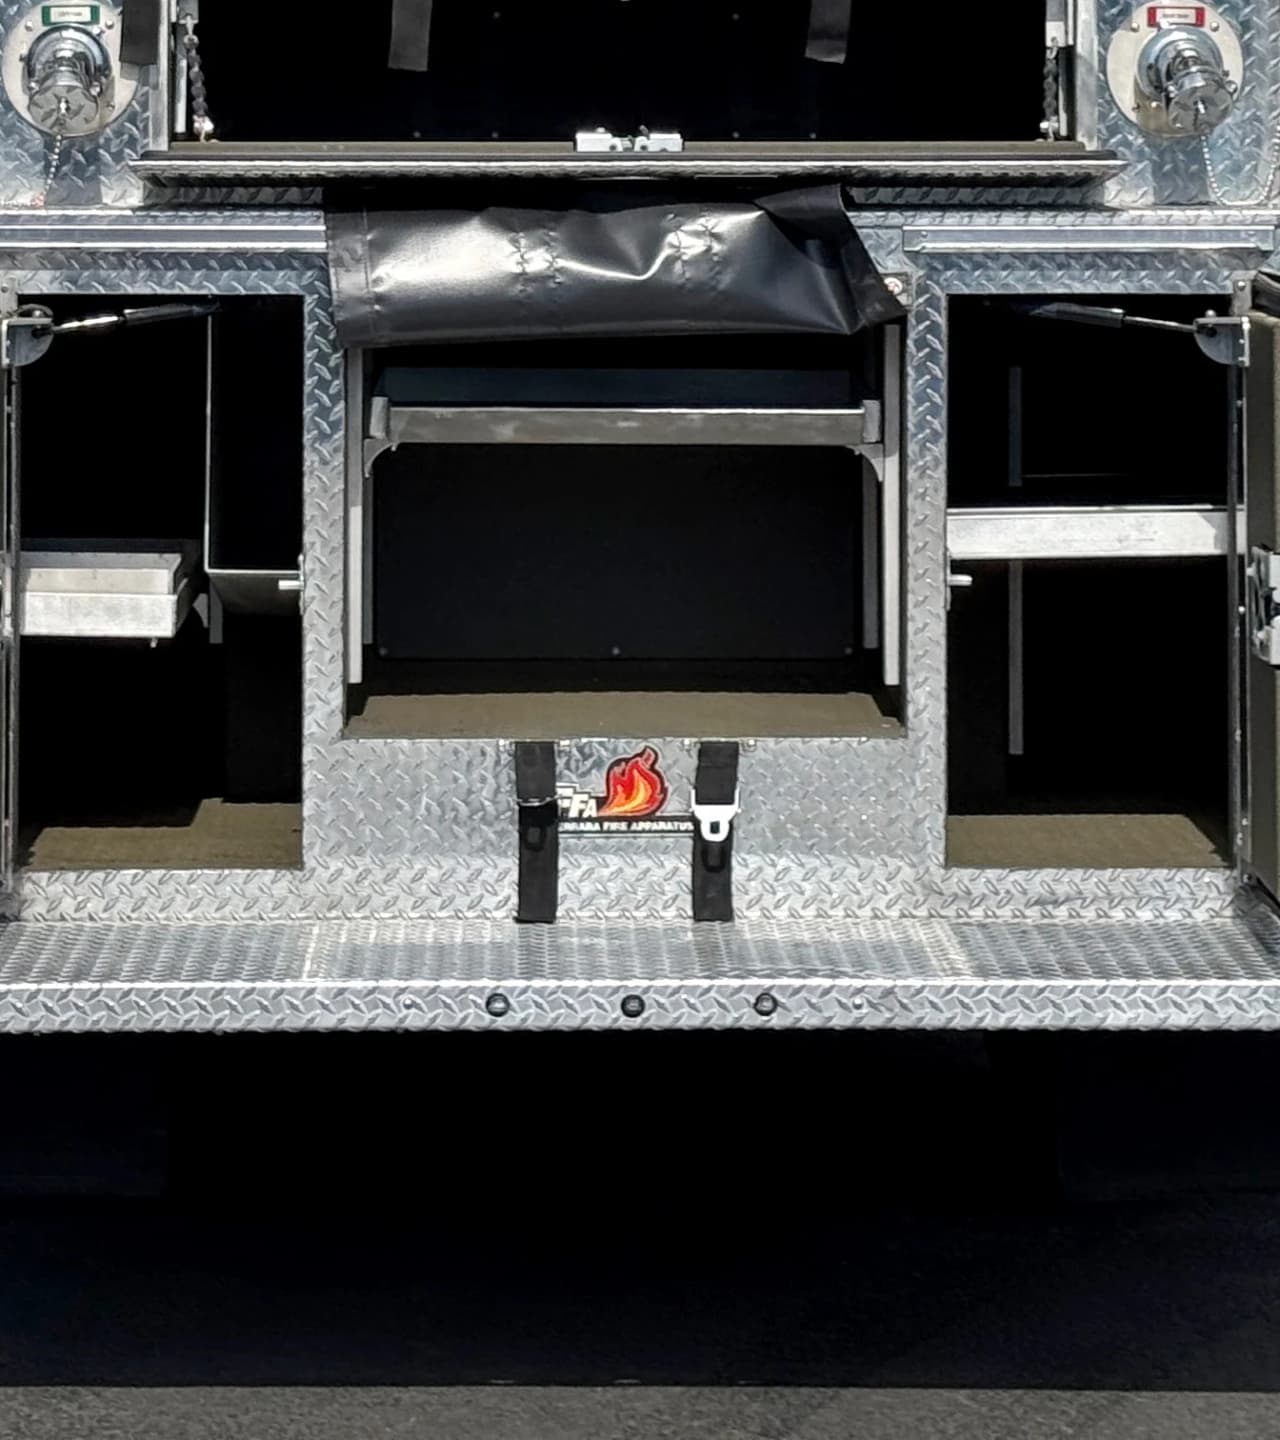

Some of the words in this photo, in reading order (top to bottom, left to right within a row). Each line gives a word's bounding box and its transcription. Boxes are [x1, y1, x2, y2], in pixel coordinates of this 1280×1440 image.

[558, 821, 601, 831] ERRARA
[603, 821, 628, 831] FIRE
[630, 821, 694, 831] APPARATUS
